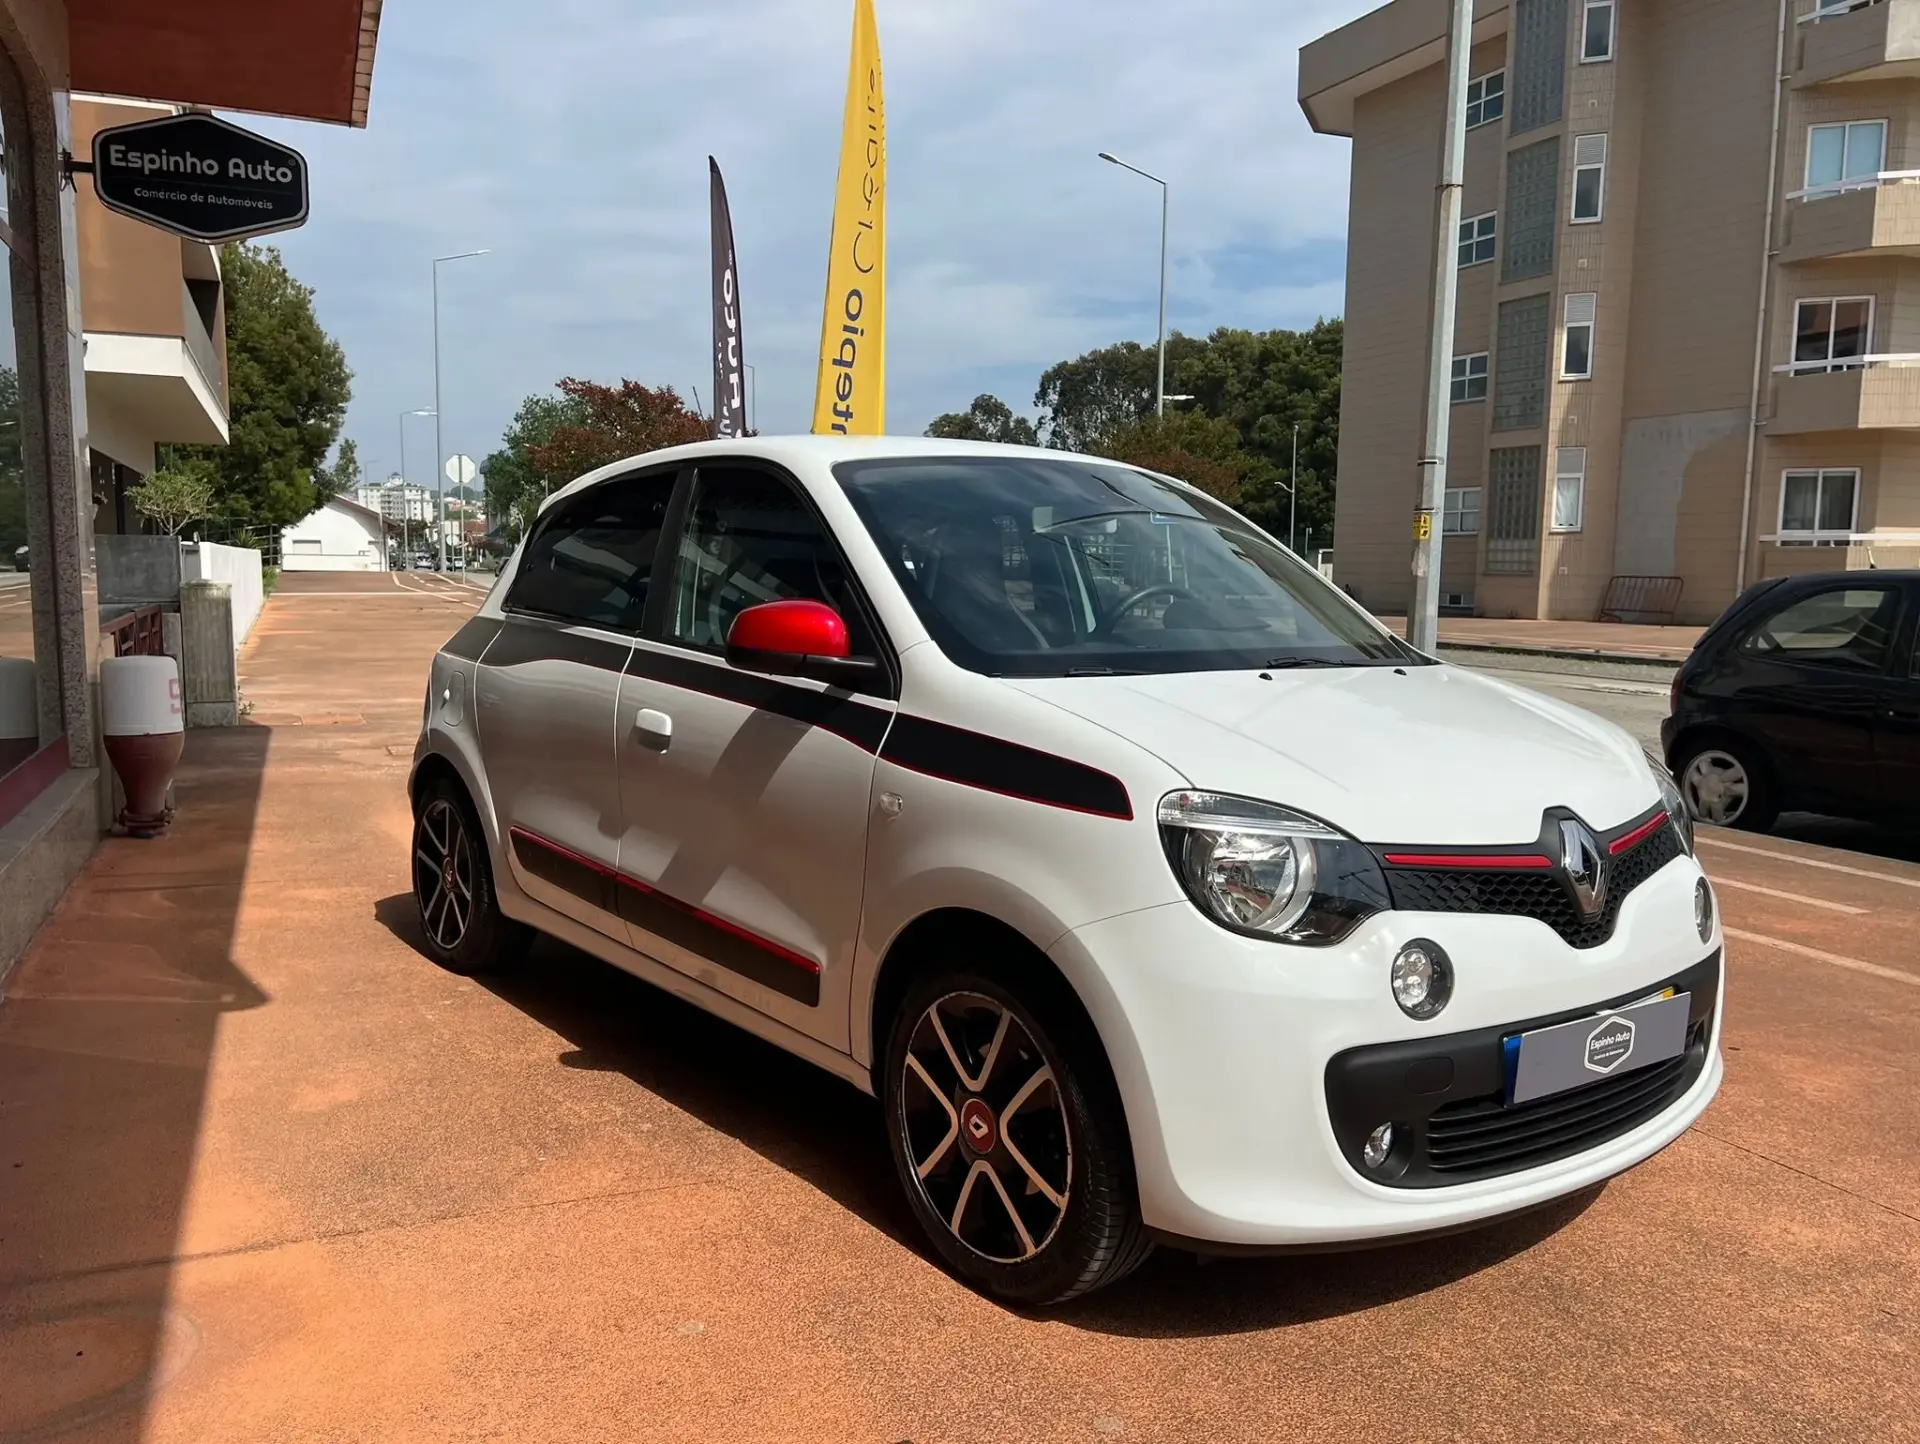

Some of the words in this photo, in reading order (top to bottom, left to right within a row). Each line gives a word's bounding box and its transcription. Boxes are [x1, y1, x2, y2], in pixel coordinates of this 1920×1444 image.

[109, 145, 219, 175] Espinho
[228, 157, 293, 183] Auto
[134, 187, 187, 201] Comércio
[190, 192, 204, 203] de
[208, 194, 273, 209] Automóveis
[1590, 1036, 1614, 1050] Espinho
[1615, 1031, 1630, 1043] Auto
